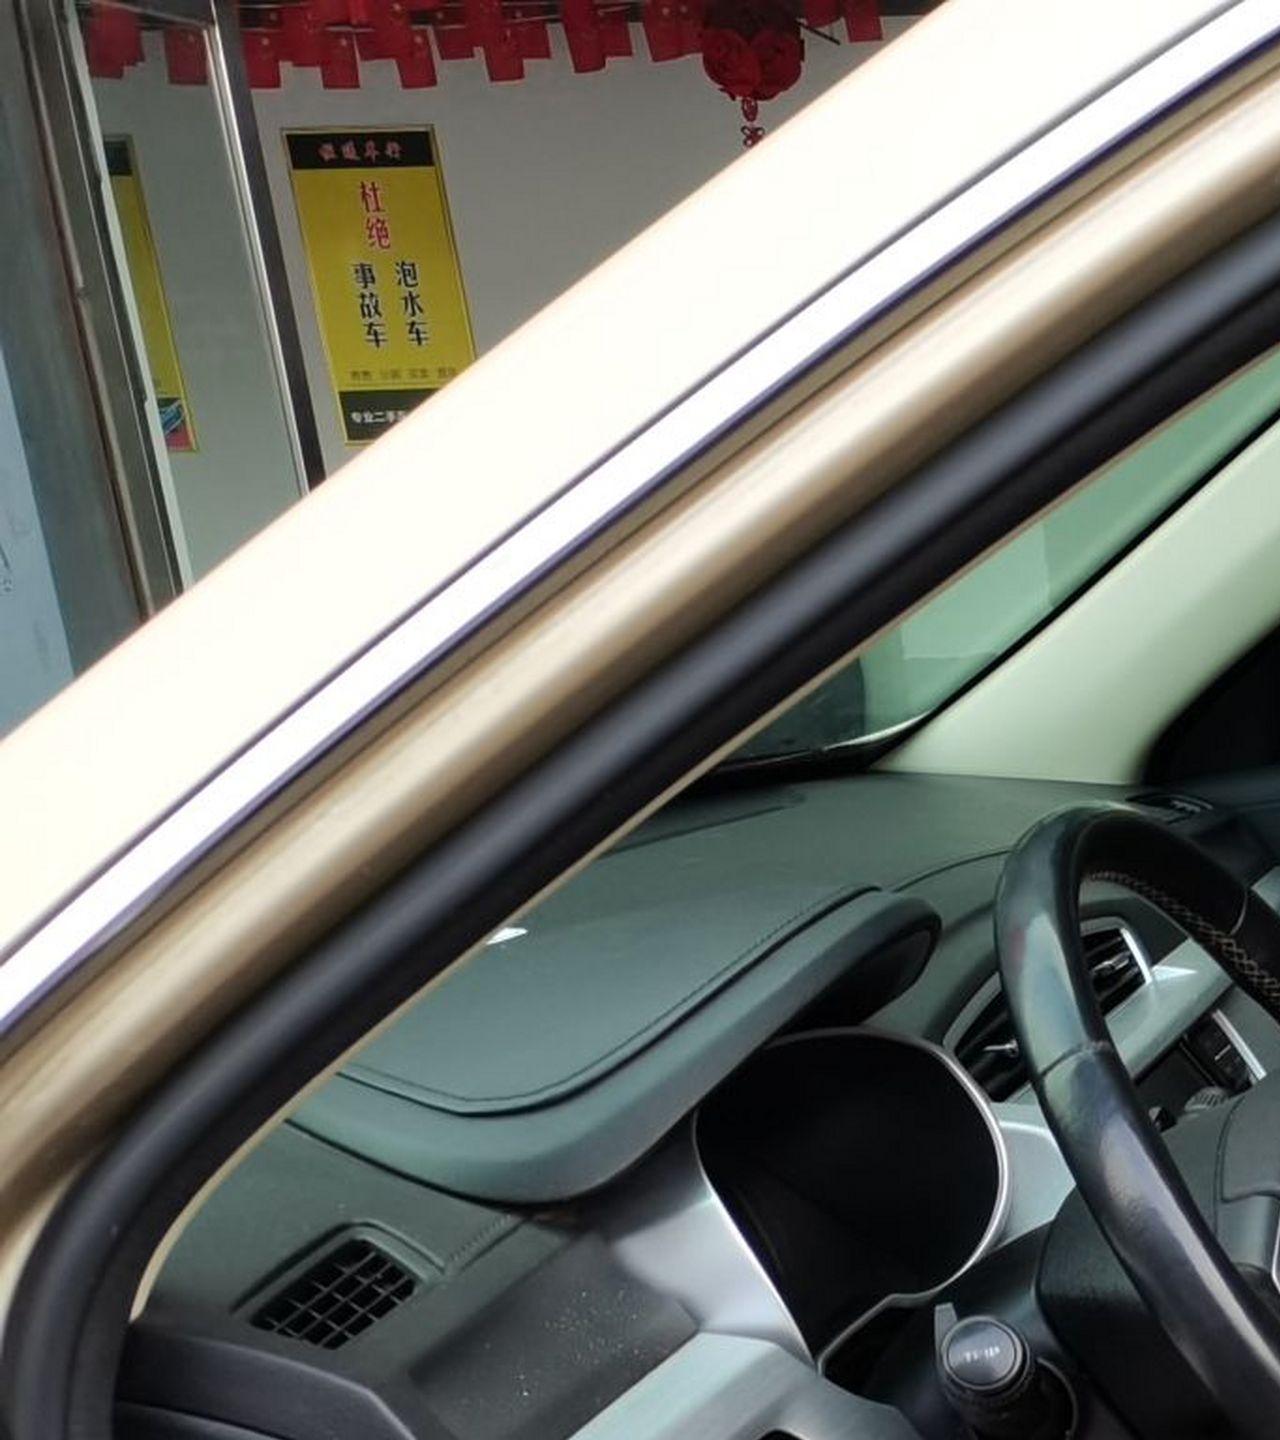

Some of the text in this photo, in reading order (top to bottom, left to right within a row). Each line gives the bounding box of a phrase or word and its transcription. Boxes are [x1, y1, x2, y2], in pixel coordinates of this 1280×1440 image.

[360, 181, 391, 249] 杜绝
[354, 263, 388, 348] 事故车
[395, 261, 429, 346] 泡水车
